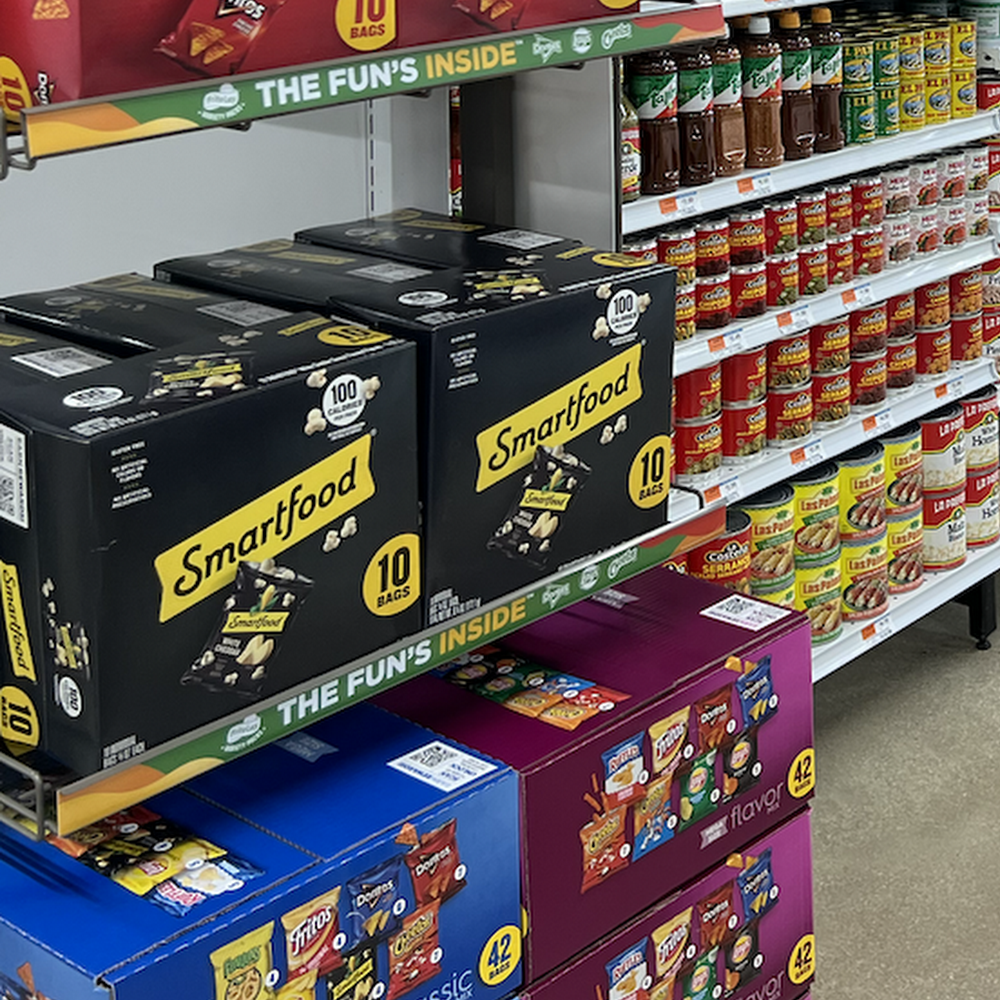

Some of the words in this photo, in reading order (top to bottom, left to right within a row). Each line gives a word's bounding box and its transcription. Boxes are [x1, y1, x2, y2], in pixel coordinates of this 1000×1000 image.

[350, 24, 387, 40] BAGS
[256, 71, 324, 108] THE
[329, 55, 420, 100] FUN'S
[425, 41, 518, 79] INSIDE
[613, 294, 633, 315] 100
[331, 379, 357, 404] 100
[487, 363, 630, 471] Smartfood
[639, 446, 666, 488] 10
[638, 481, 664, 503] BAGS
[173, 456, 358, 598] Smartfood
[376, 545, 412, 594] 10
[377, 585, 411, 610] BAGS
[3, 569, 31, 671] Smartfood
[278, 682, 340, 724] THE
[347, 640, 432, 697] FUN'S
[439, 602, 527, 655] INSIDE
[68, 687, 79, 712] 100
[8, 701, 33, 737] 10
[794, 758, 812, 784] 42
[730, 782, 784, 829] flavor
[416, 846, 451, 877] Doritos
[356, 879, 395, 907] Doritos
[290, 904, 332, 957] Fritos
[487, 932, 514, 972] 42
[794, 942, 813, 969] 42
[488, 963, 511, 982] BAGS
